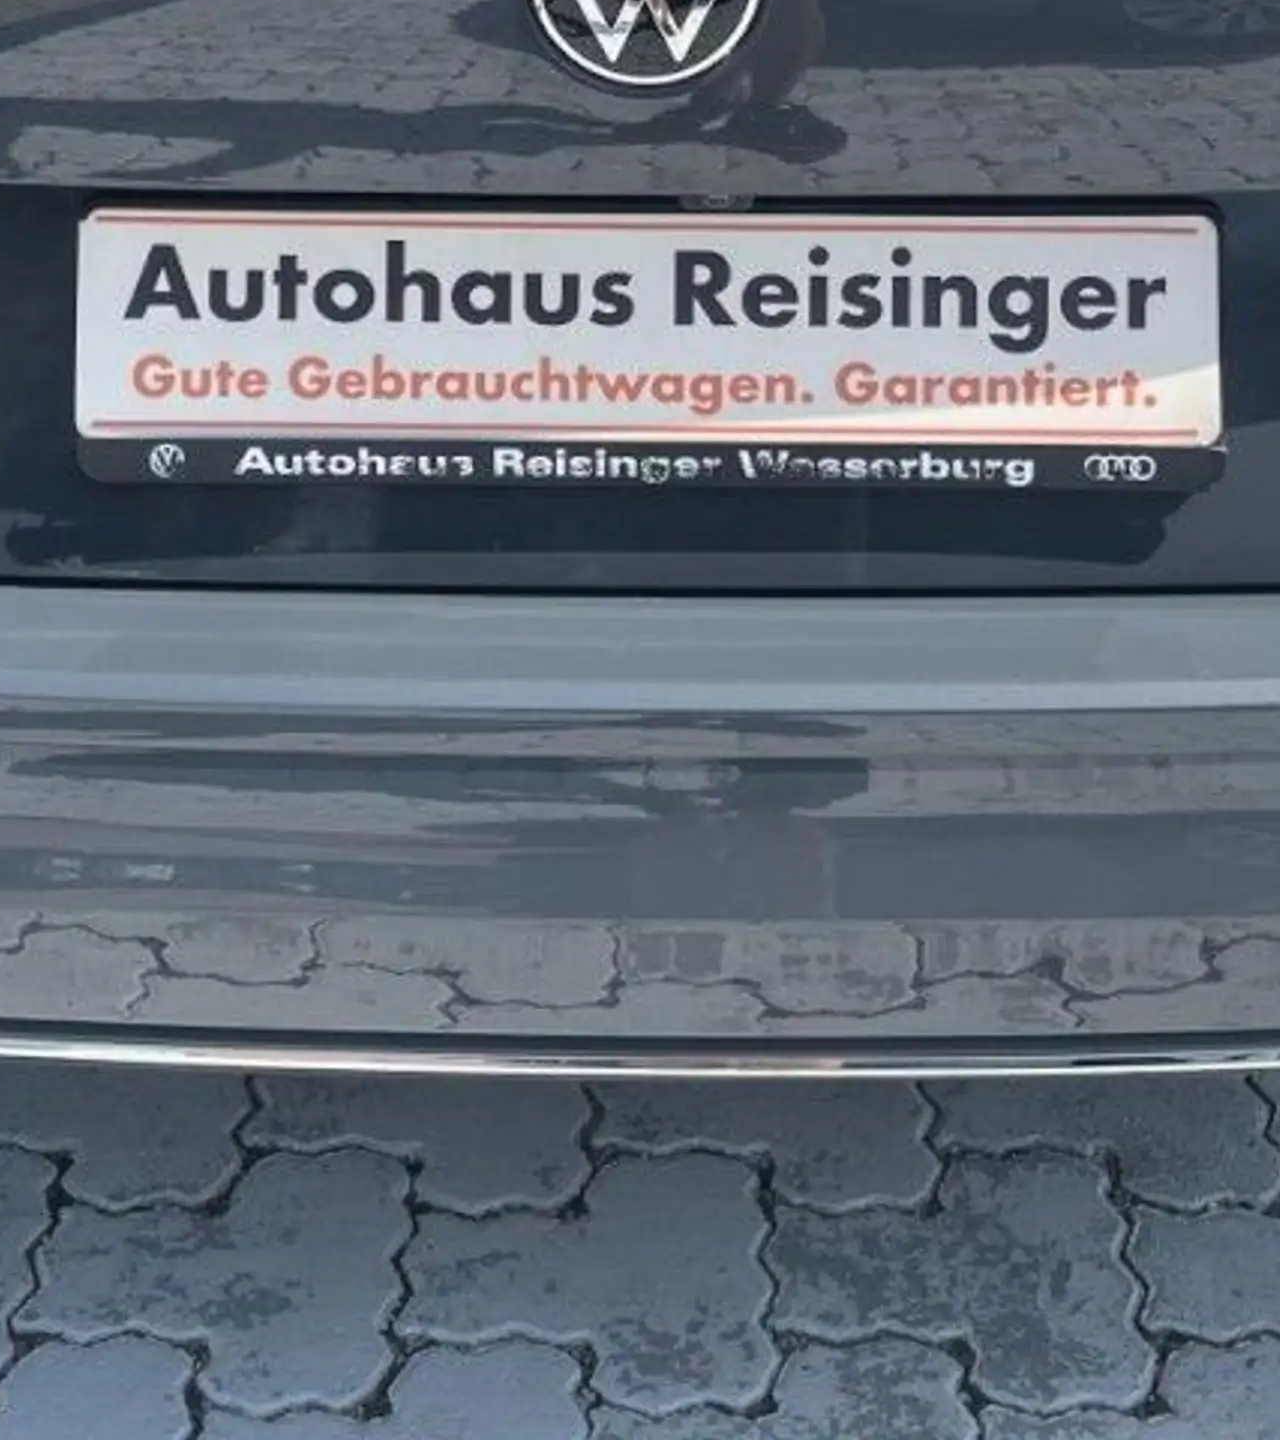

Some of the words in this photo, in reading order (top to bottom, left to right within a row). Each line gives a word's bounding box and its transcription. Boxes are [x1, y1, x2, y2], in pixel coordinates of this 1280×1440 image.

[123, 239, 636, 327] Autohaus
[672, 245, 1168, 355] Reisinger
[131, 354, 269, 400] Gute
[287, 354, 815, 416] Gebrauchtwagen.
[834, 361, 1158, 409] Garantiert.
[232, 445, 476, 478] Autohaus
[491, 446, 723, 485] Reisinger
